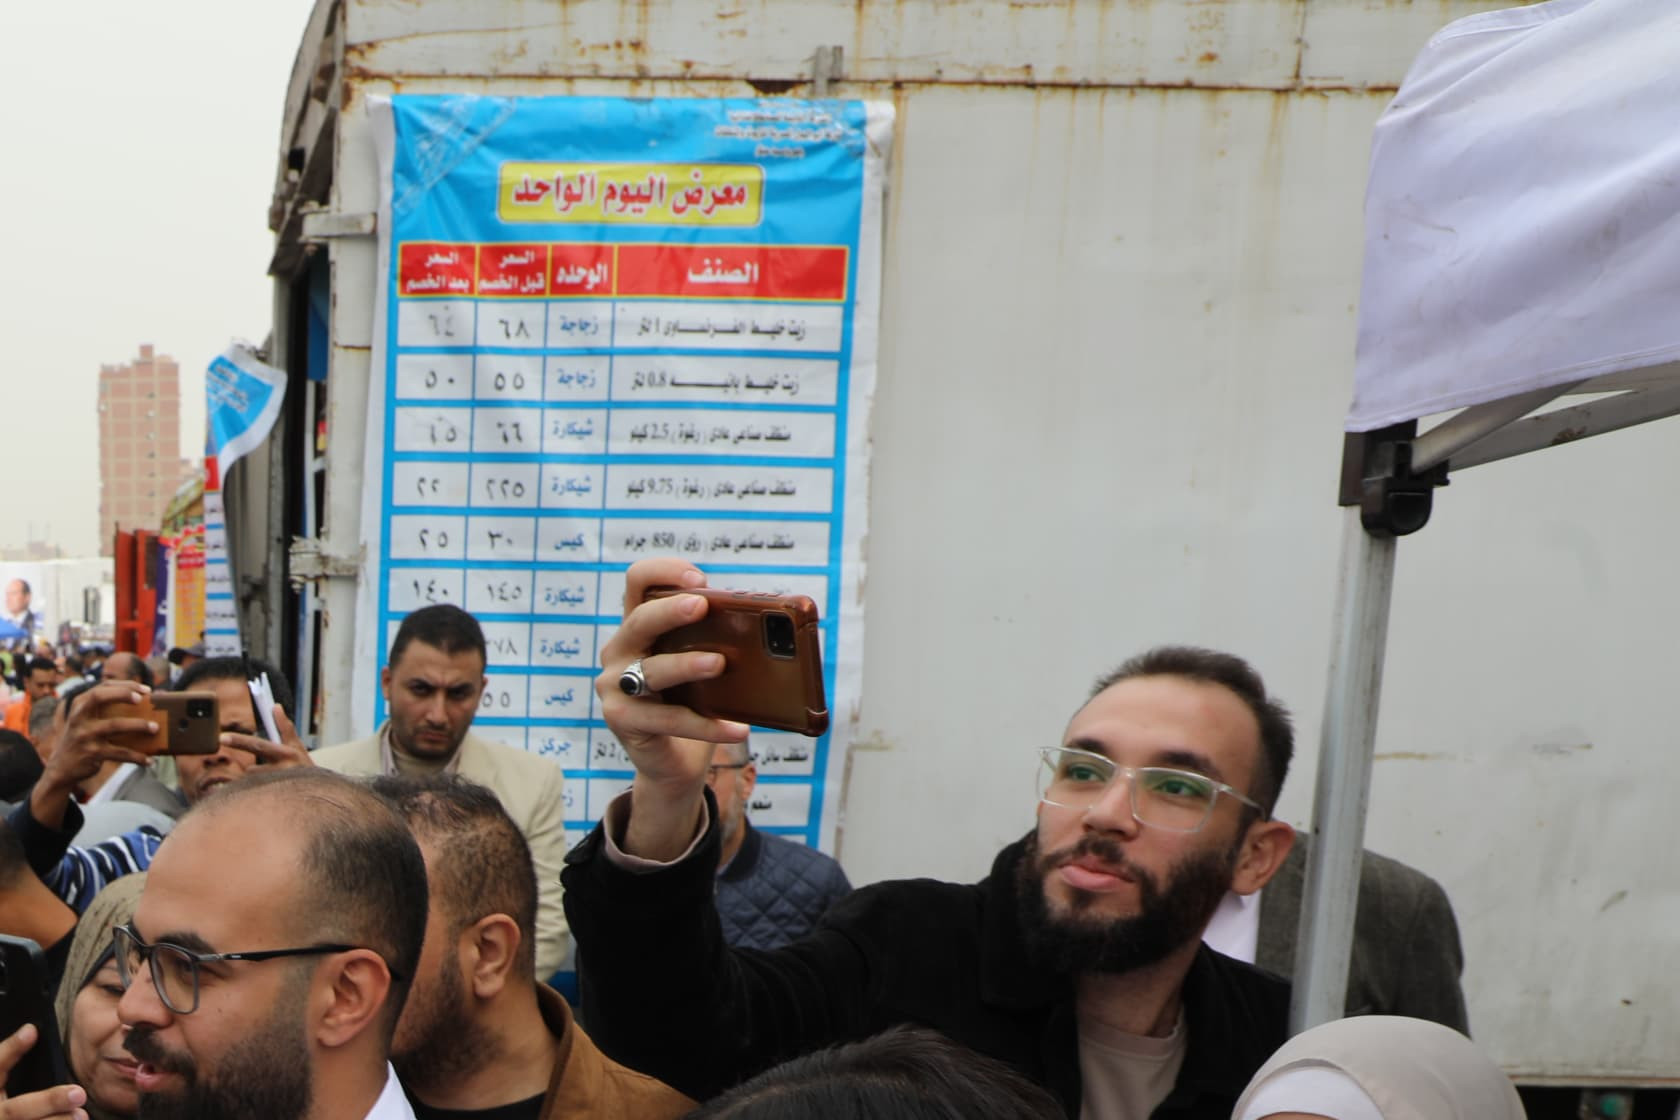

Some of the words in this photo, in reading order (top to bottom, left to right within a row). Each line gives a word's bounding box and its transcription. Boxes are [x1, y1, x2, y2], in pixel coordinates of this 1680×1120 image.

[514, 173, 596, 213] الواحد
[604, 174, 665, 213] اليوم
[672, 171, 746, 214] معرض
[425, 252, 460, 268] السعر
[499, 251, 536, 268] السعر
[687, 257, 760, 284] الصنف
[406, 273, 447, 292] الخصم
[448, 275, 471, 292] بعد
[478, 273, 519, 292] الخصم
[520, 273, 546, 292] قبل
[498, 319, 531, 339] ٦٨
[425, 370, 455, 389] ٥٠
[494, 372, 525, 391] ٥٥
[418, 528, 448, 550] ٢٥
[544, 585, 585, 606] شيكارة
[540, 637, 580, 658] شيكارة
[544, 687, 575, 706] كيس
